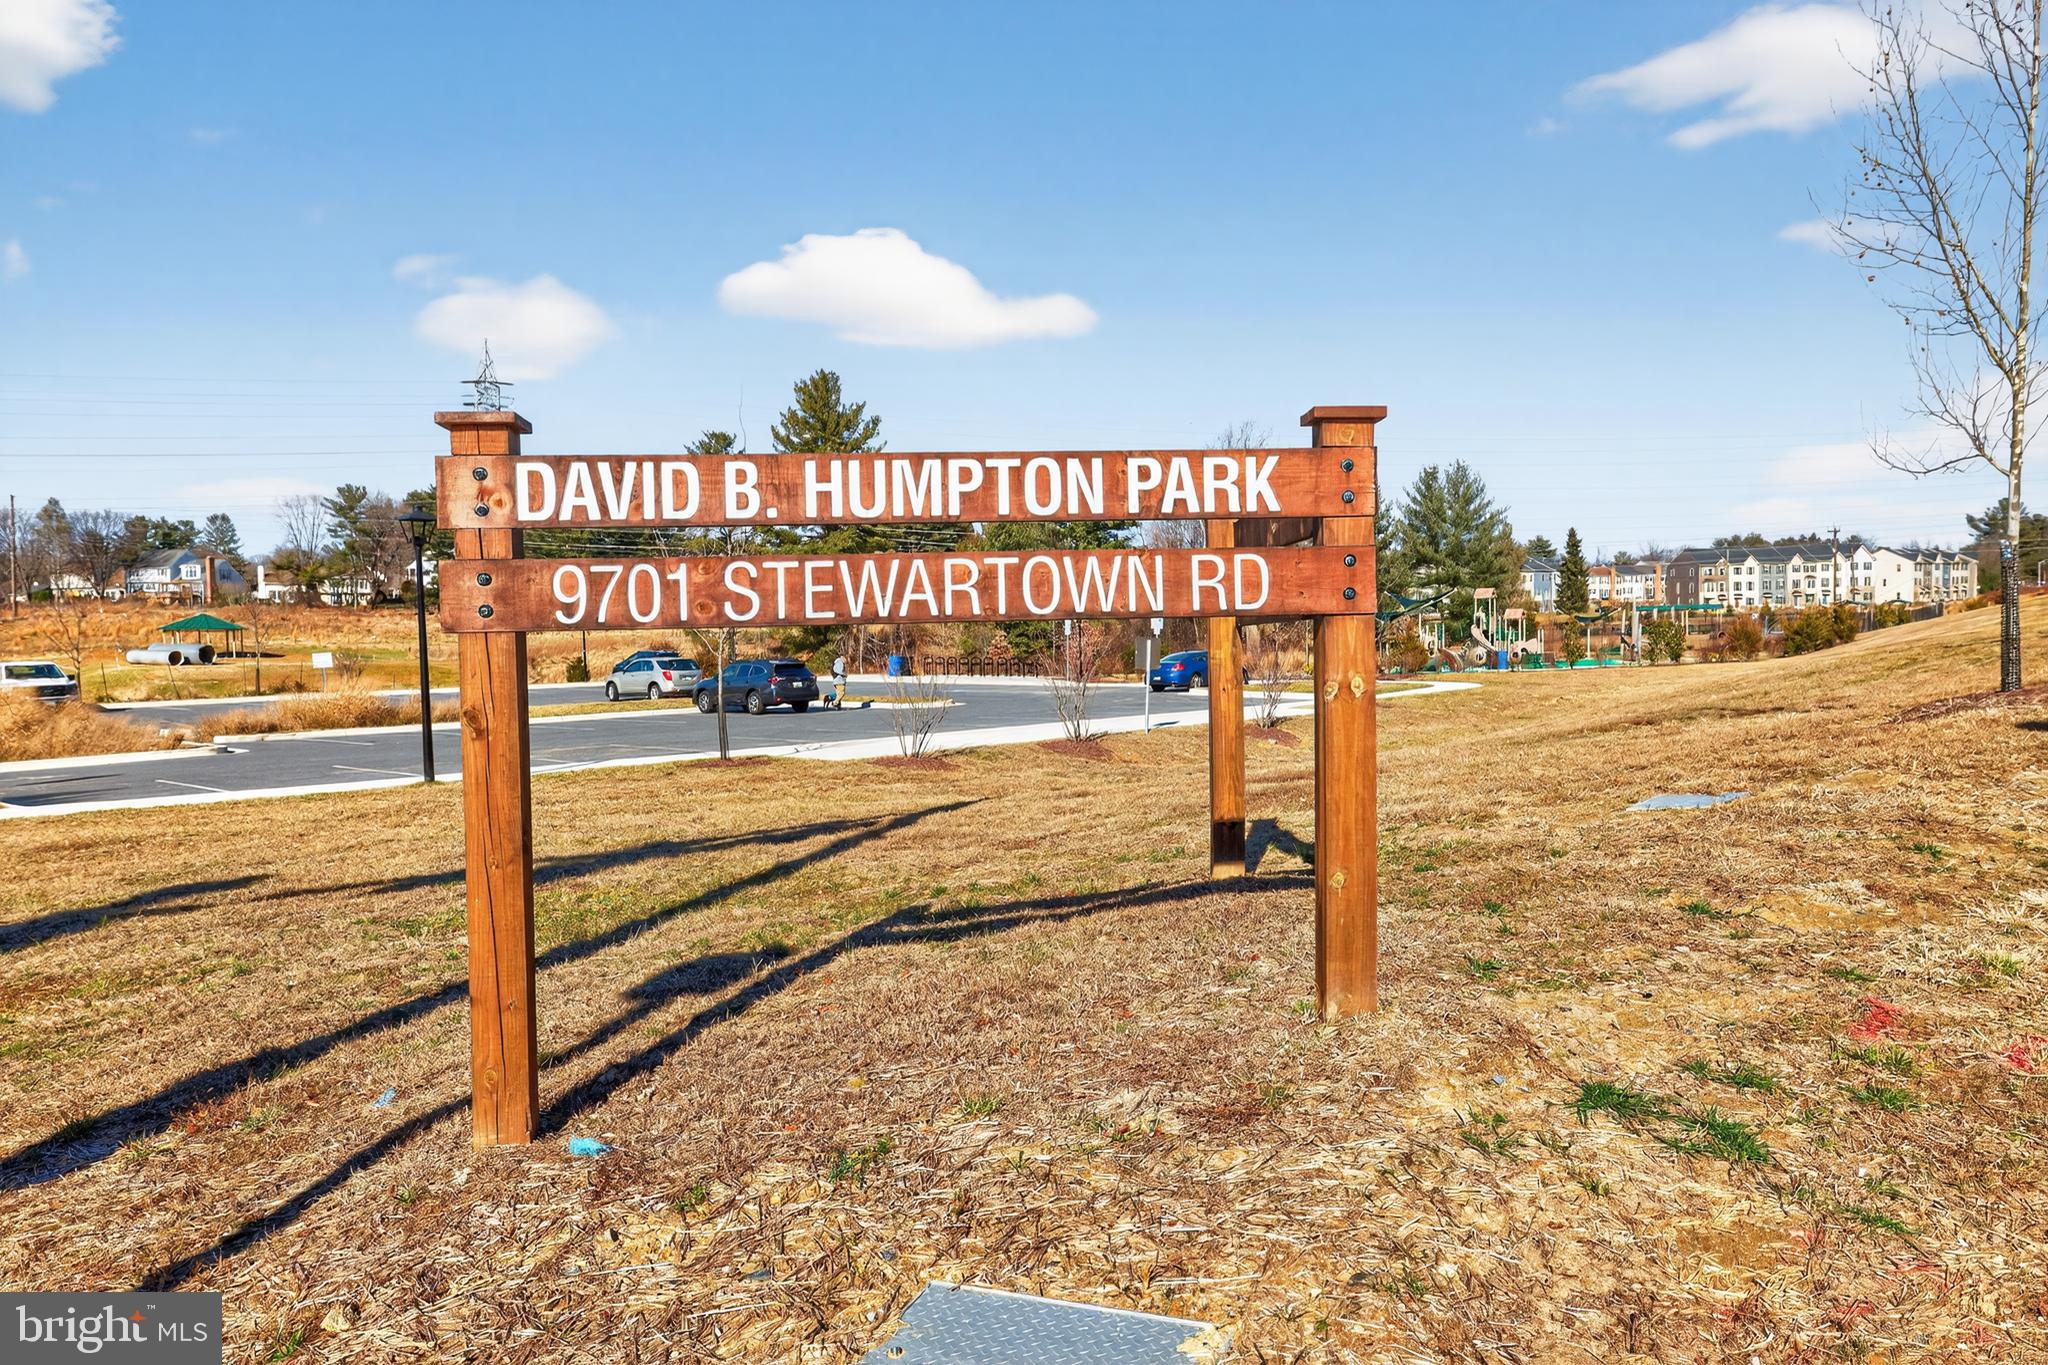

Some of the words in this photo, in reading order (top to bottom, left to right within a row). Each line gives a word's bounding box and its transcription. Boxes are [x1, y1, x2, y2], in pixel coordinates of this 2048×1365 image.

[515, 461, 701, 522] DAVID
[723, 460, 778, 519] B.
[803, 456, 1104, 518] HUMPTON
[1126, 455, 1281, 514] PARK
[552, 562, 688, 625] 9701
[723, 554, 1164, 621] STEWARTOWN
[1191, 553, 1270, 611] RD
